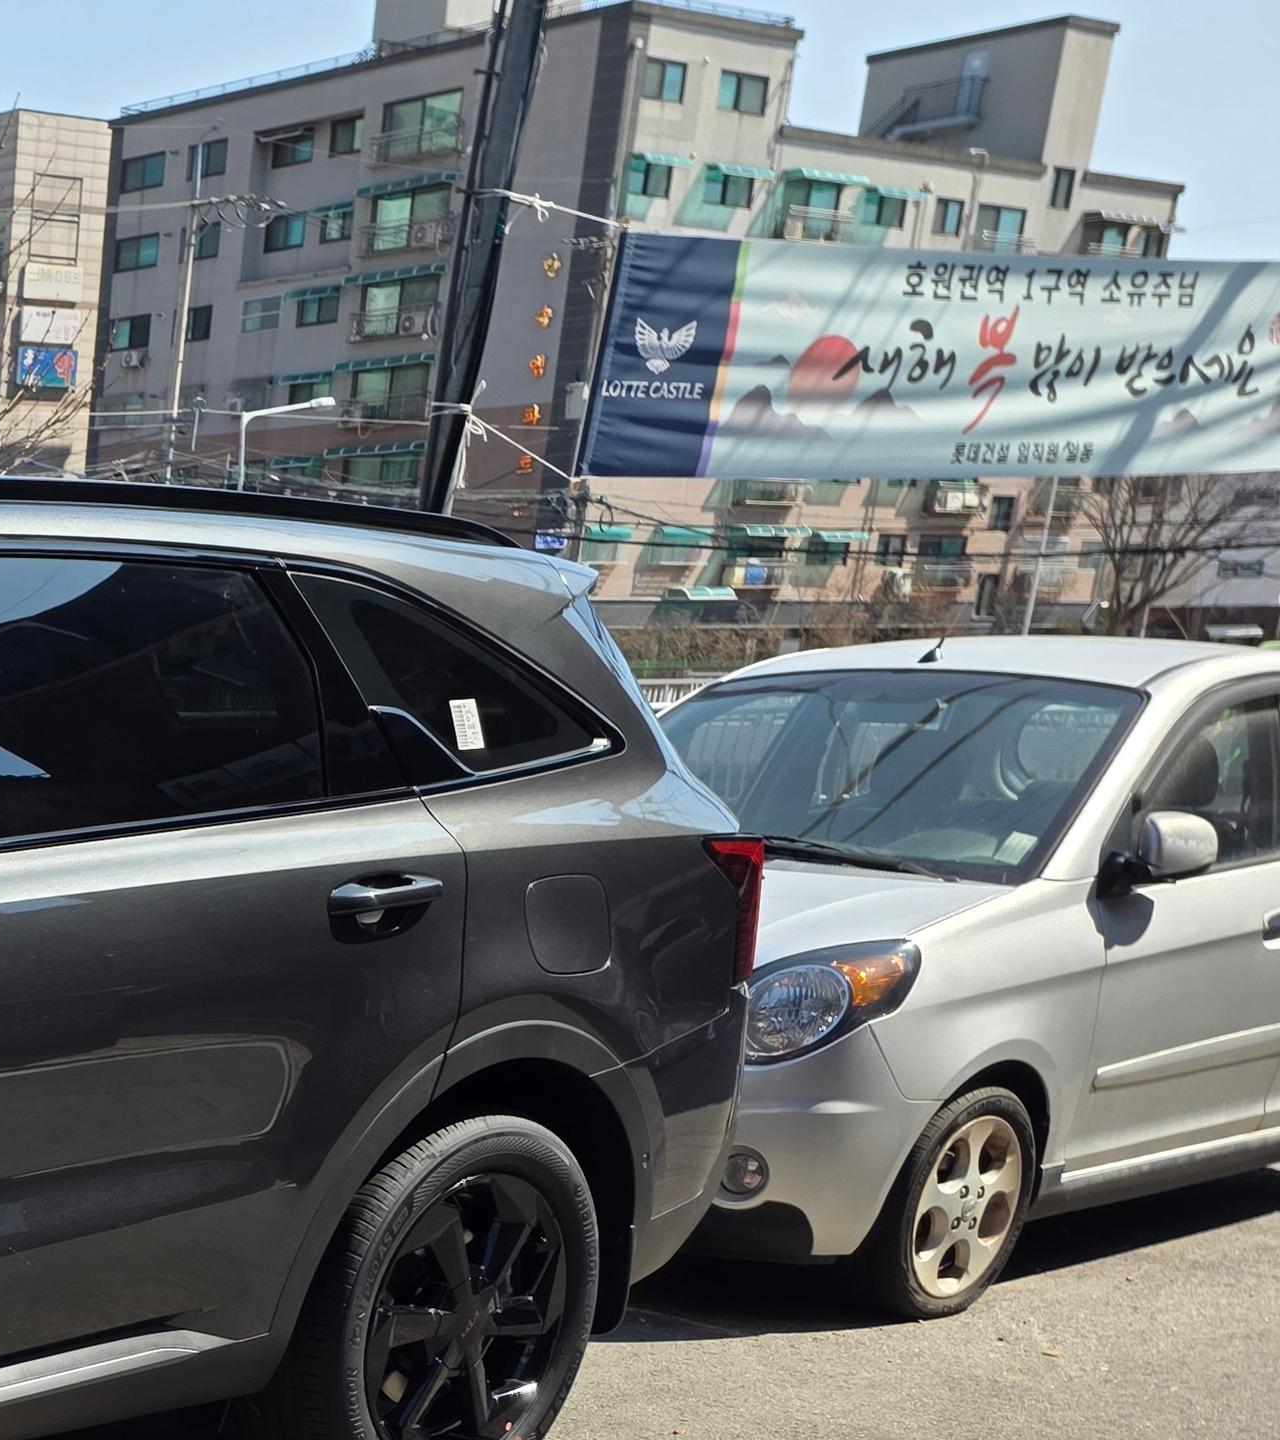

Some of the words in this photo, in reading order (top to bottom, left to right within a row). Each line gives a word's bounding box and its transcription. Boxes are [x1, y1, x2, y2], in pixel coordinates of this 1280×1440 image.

[903, 260, 1010, 302] 호원권역
[1023, 267, 1091, 304] 1구역
[1101, 269, 1200, 307] 소유주님
[601, 379, 648, 399] LOTTE
[649, 380, 705, 400] CASTLE
[831, 320, 957, 391] 새해
[961, 304, 1021, 435] 복
[1029, 334, 1101, 402] 많이
